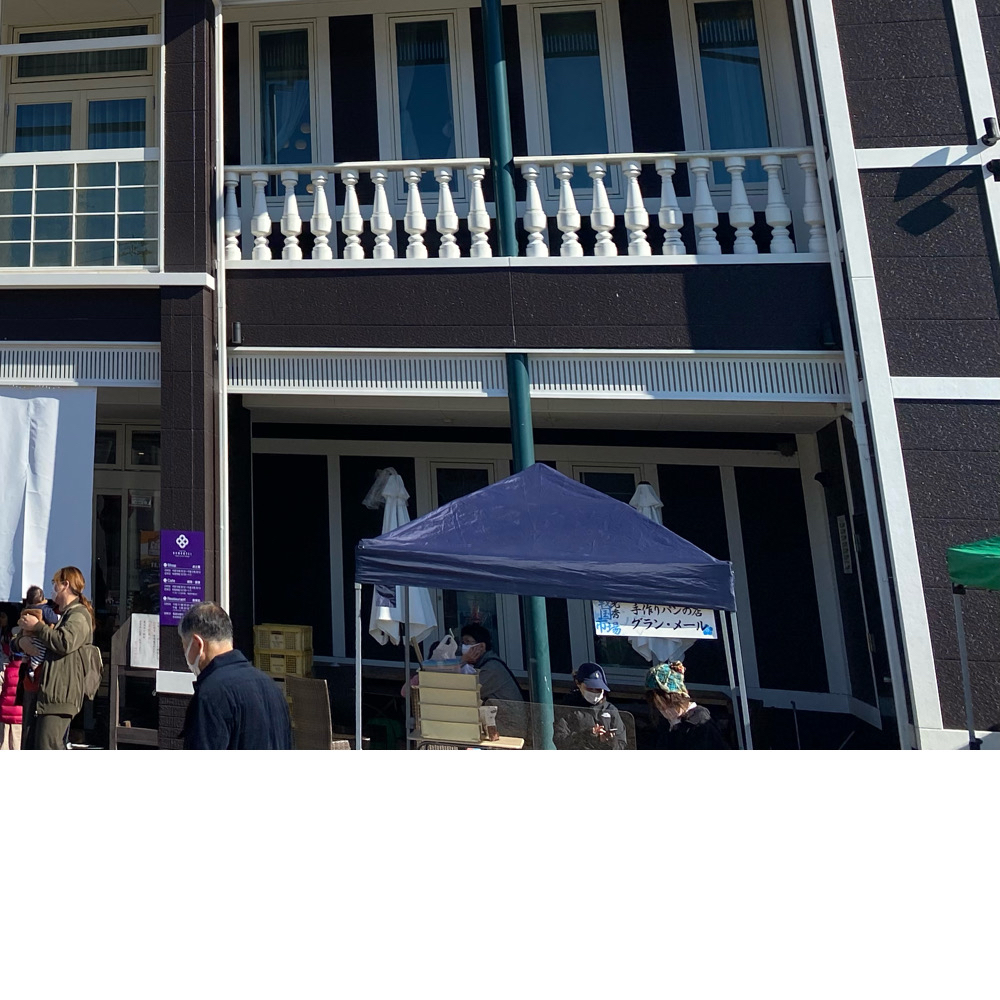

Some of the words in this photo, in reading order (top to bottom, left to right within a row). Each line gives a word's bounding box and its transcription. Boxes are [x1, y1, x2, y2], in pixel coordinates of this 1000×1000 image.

[631, 602, 703, 617] 手作りパンの店
[631, 618, 708, 632] グラン・メール
